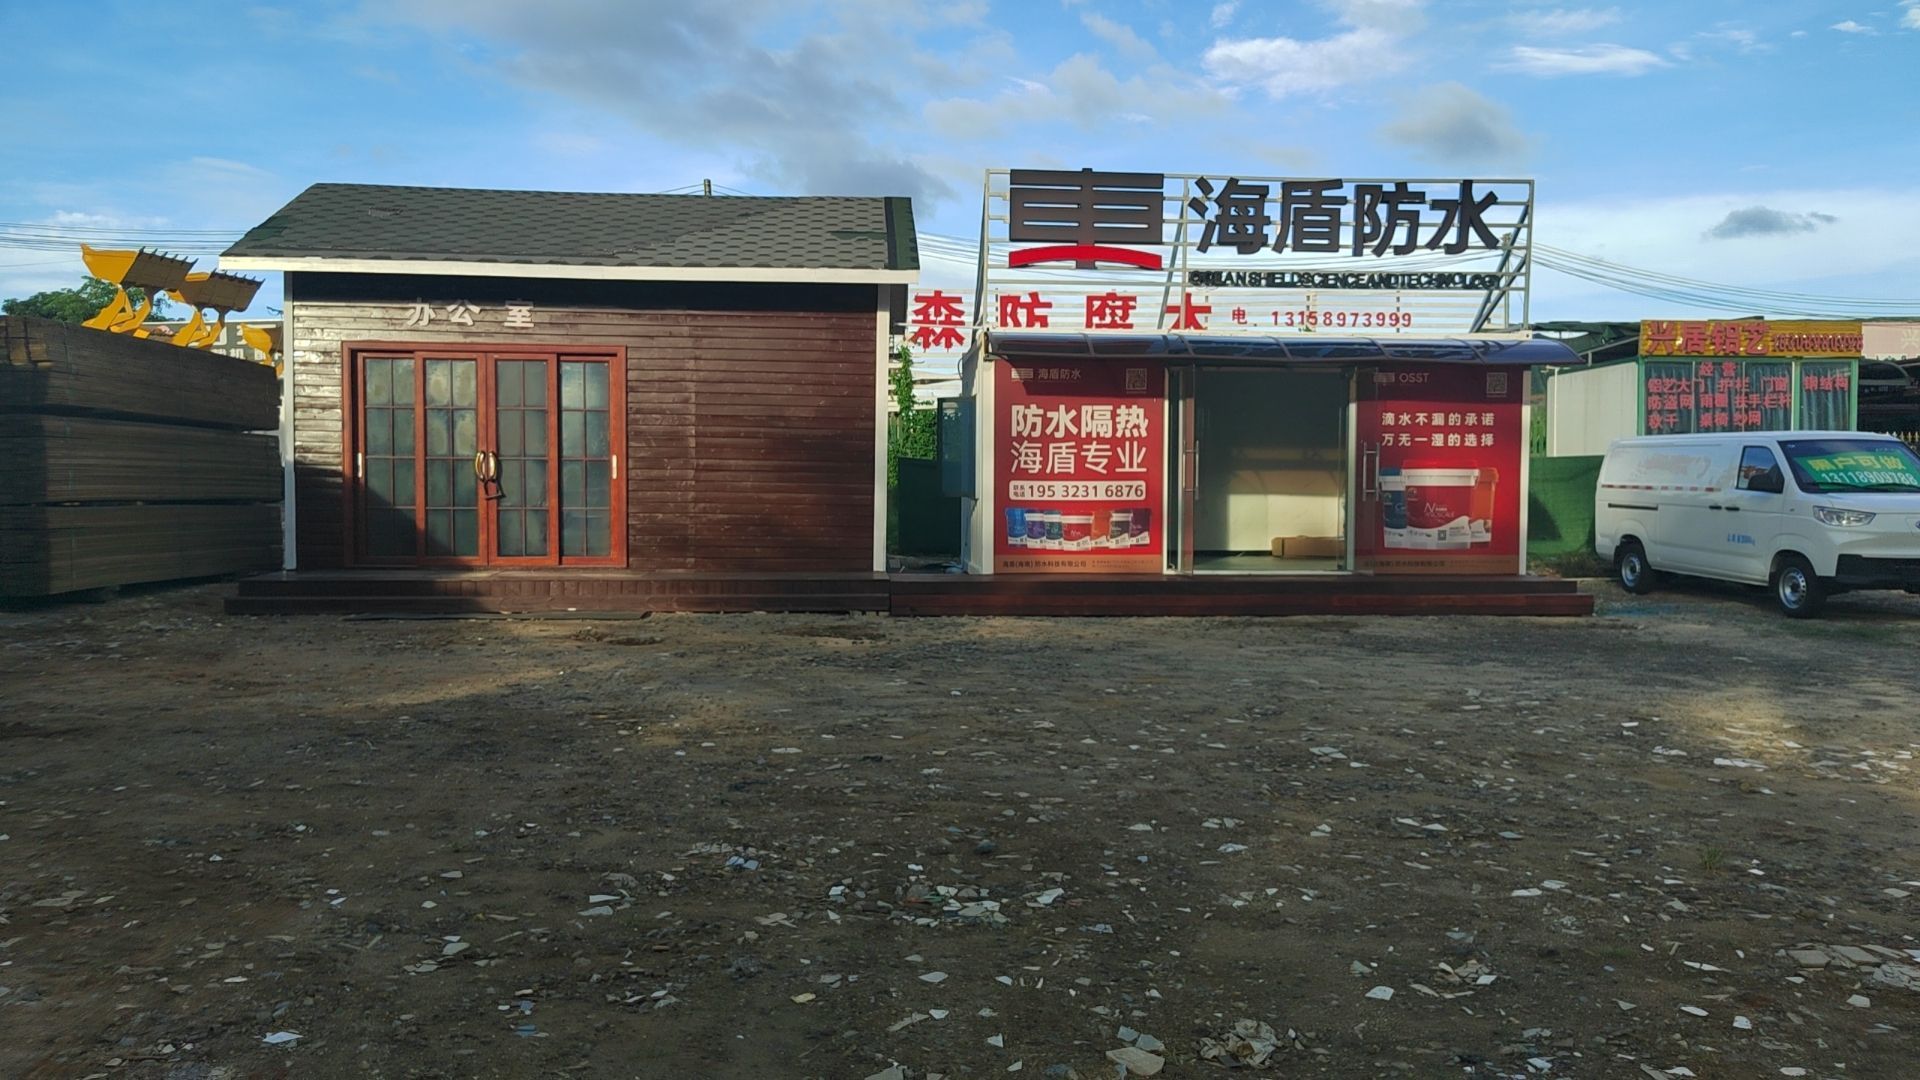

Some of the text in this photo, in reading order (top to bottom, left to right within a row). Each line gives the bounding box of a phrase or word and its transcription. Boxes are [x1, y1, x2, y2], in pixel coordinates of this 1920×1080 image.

[1188, 177, 1500, 256] 海盾防水
[404, 297, 535, 328] 办公室
[1271, 310, 1412, 328] 13158973999
[1646, 321, 1769, 355] 兴居铝艺
[1038, 368, 1082, 381] 海盾防水
[1399, 372, 1430, 384] OSST
[1011, 404, 1149, 439] 防水隔热
[1382, 412, 1496, 426] 滴水不漏的承诺
[1381, 433, 1495, 447] 万无一湿的选择
[1010, 440, 1148, 475] 海盾专业
[1821, 471, 1918, 486] 13118909788
[1028, 484, 1145, 498] 195 3231 6876
